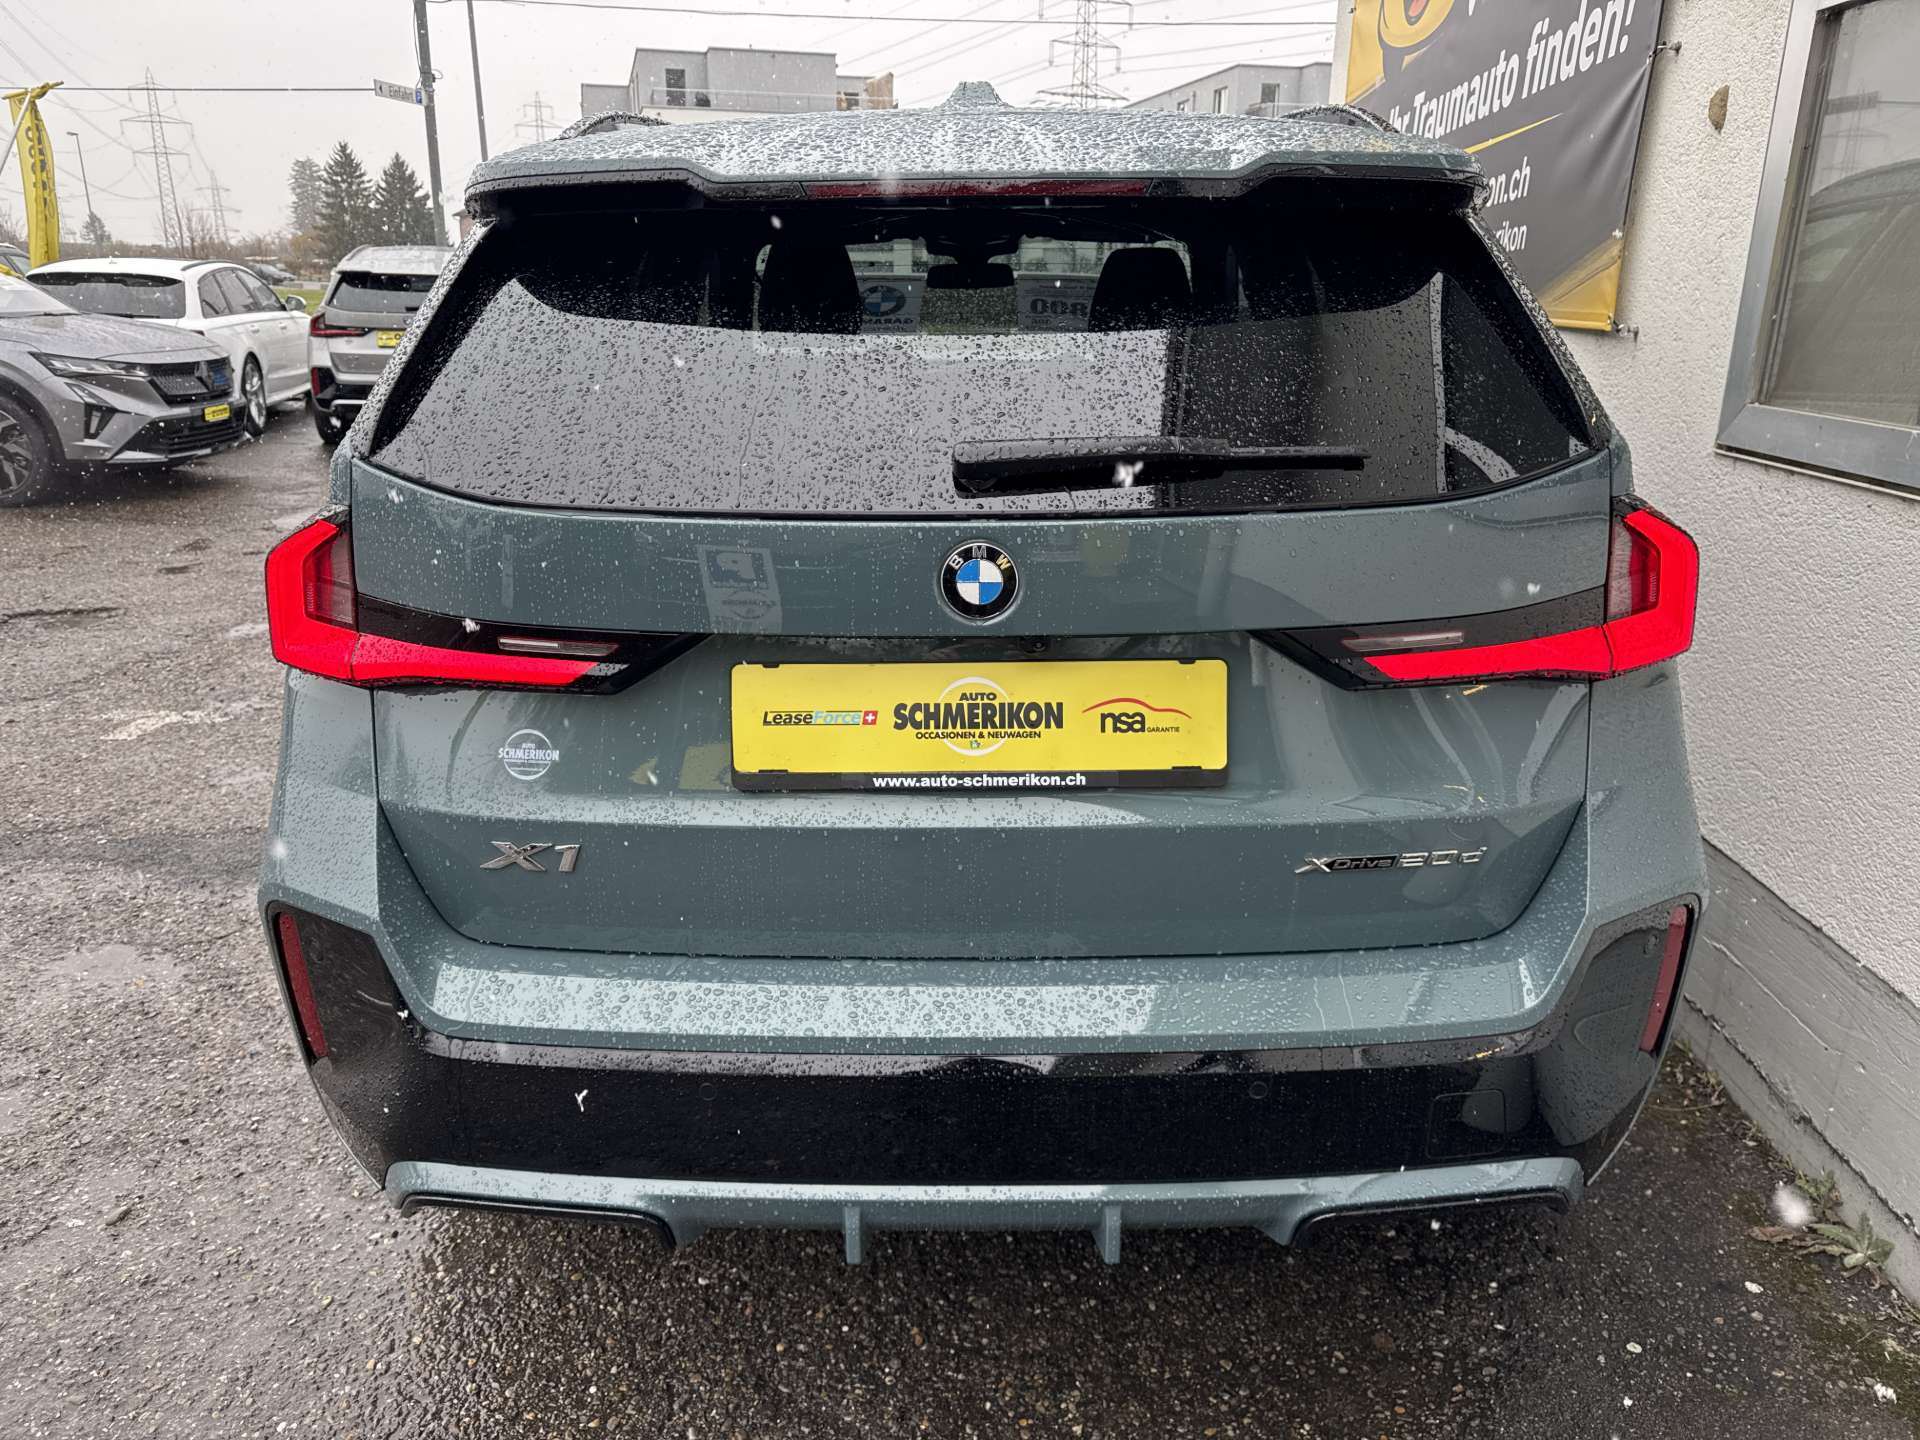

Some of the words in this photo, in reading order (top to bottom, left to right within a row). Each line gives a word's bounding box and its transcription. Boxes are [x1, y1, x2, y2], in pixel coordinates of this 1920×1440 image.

[1411, 49, 1519, 139] Traumauto
[1521, 0, 1636, 99] finden!
[949, 545, 1011, 570] BMW
[959, 692, 997, 702] AUTO
[763, 710, 861, 725] LeaseForce
[893, 701, 1064, 731] SCHMERIKON
[1100, 712, 1146, 733] nsa
[916, 731, 976, 740] OCCASIONEN
[978, 731, 985, 740] &
[988, 731, 1041, 740] NEUWAGEN
[498, 748, 560, 761] SCHMERIKON
[873, 773, 1087, 788] www.auto-schmerikon.ch
[480, 841, 580, 872] X1
